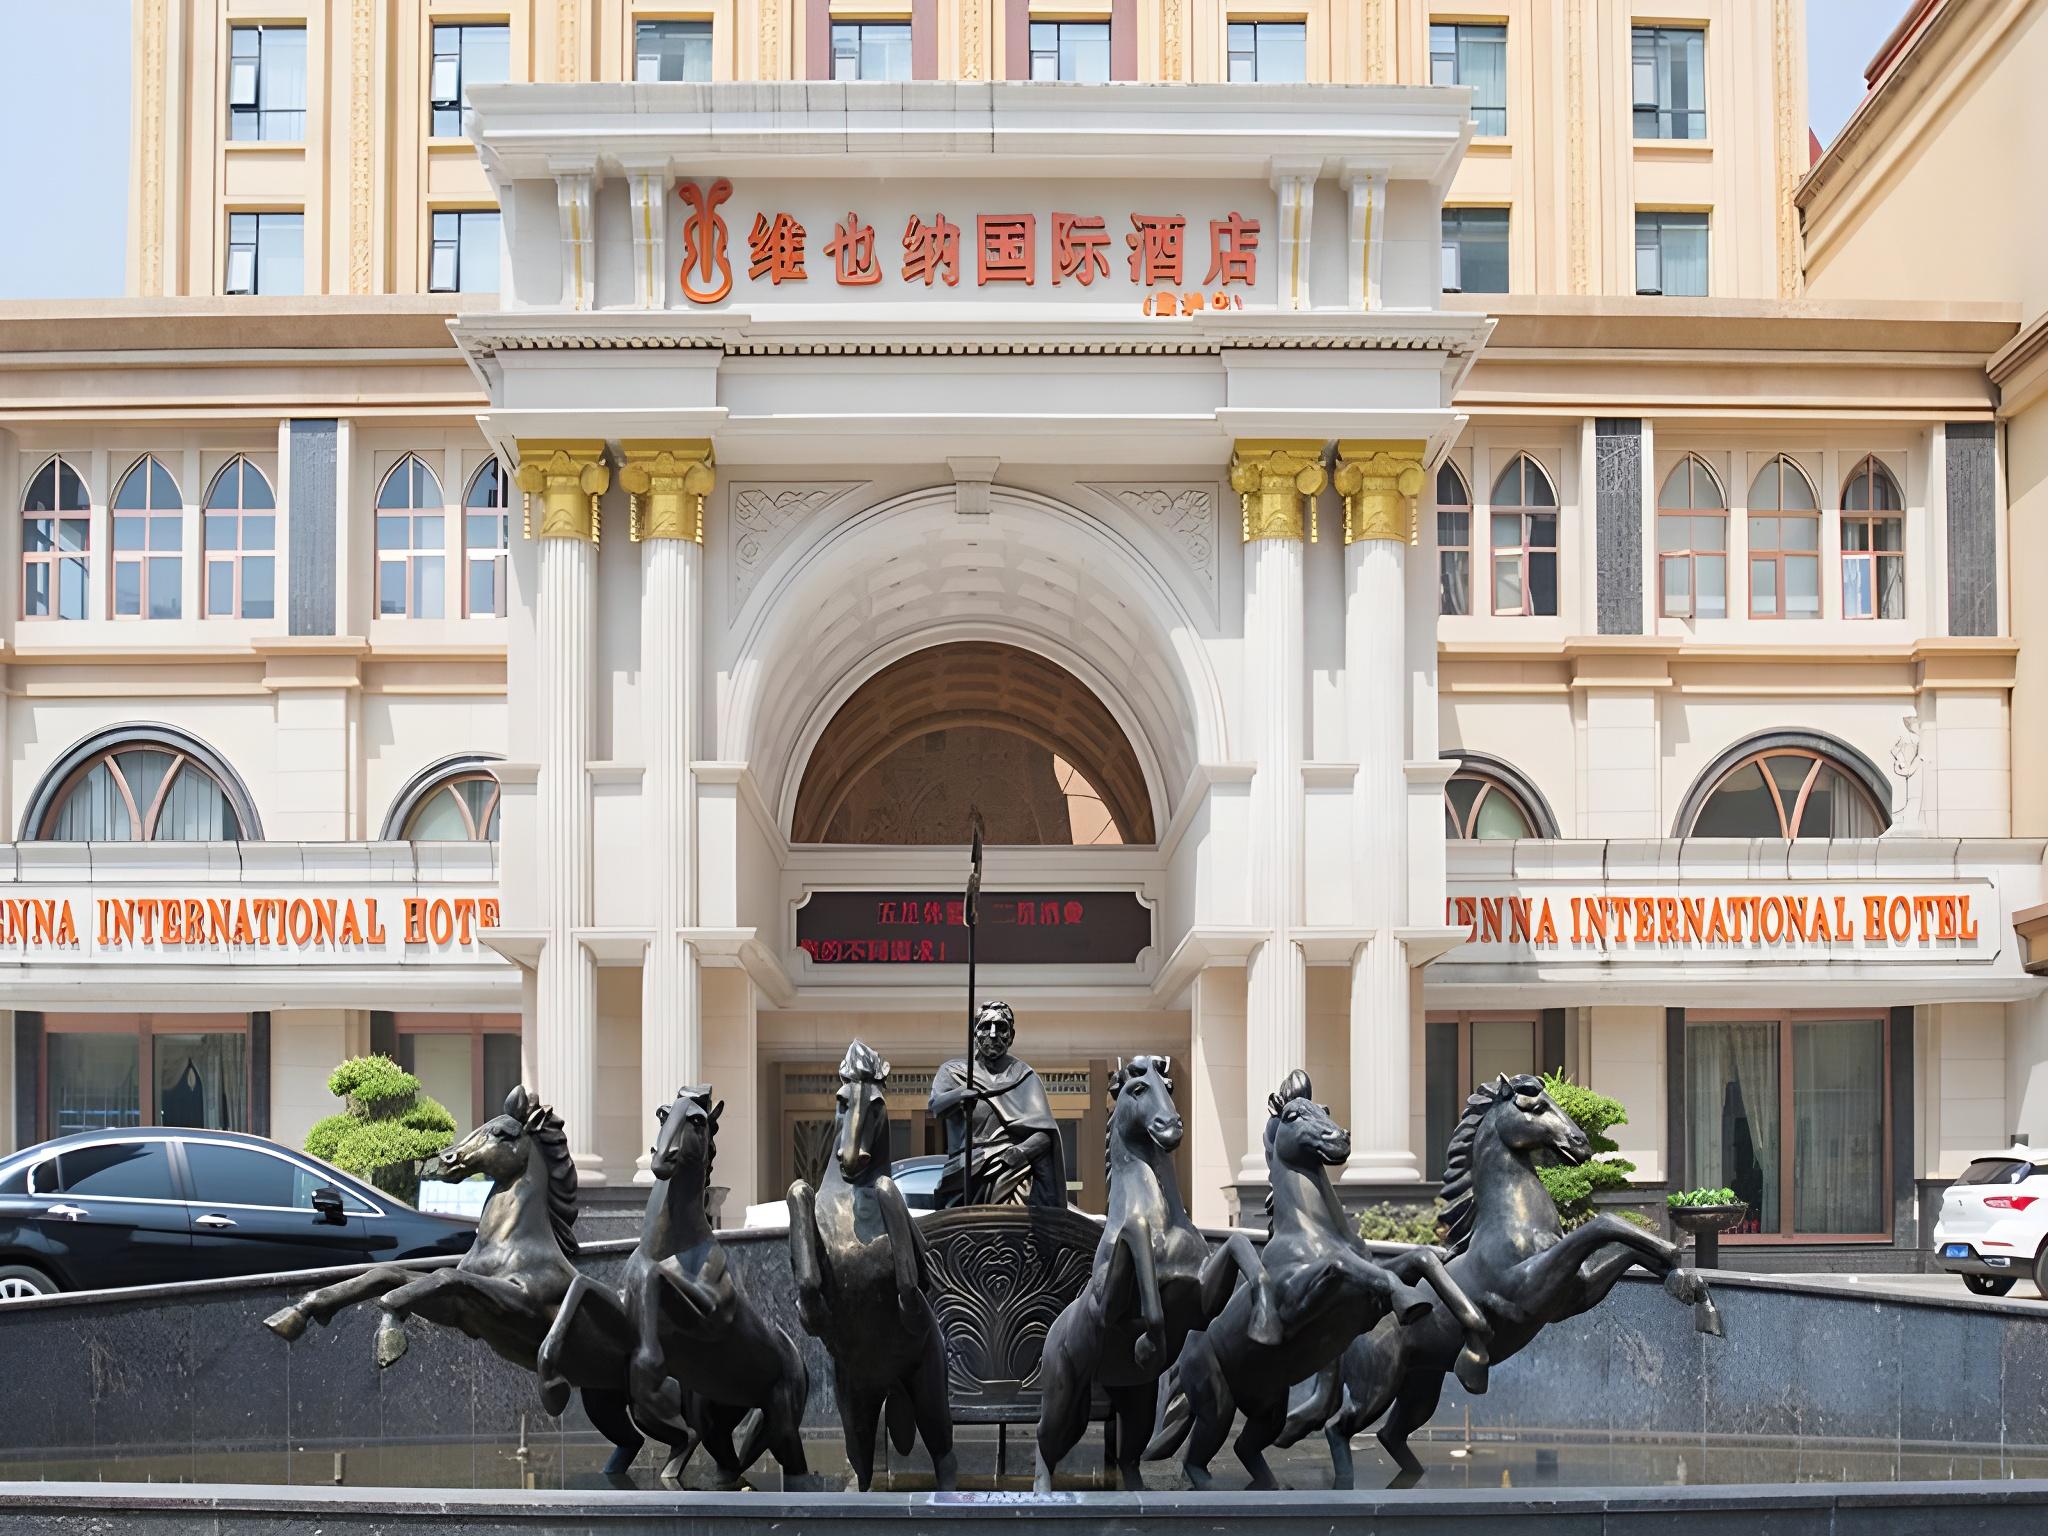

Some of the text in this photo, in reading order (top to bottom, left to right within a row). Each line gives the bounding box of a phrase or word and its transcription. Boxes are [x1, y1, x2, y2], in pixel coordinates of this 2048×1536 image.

[748, 212, 1259, 287] 维也纳国际酒店
[0, 898, 78, 945] NNA
[97, 898, 386, 945] INTERNATIONAL
[1569, 896, 1855, 944] INTERNATIONAL
[1863, 895, 1979, 942] HOTEL
